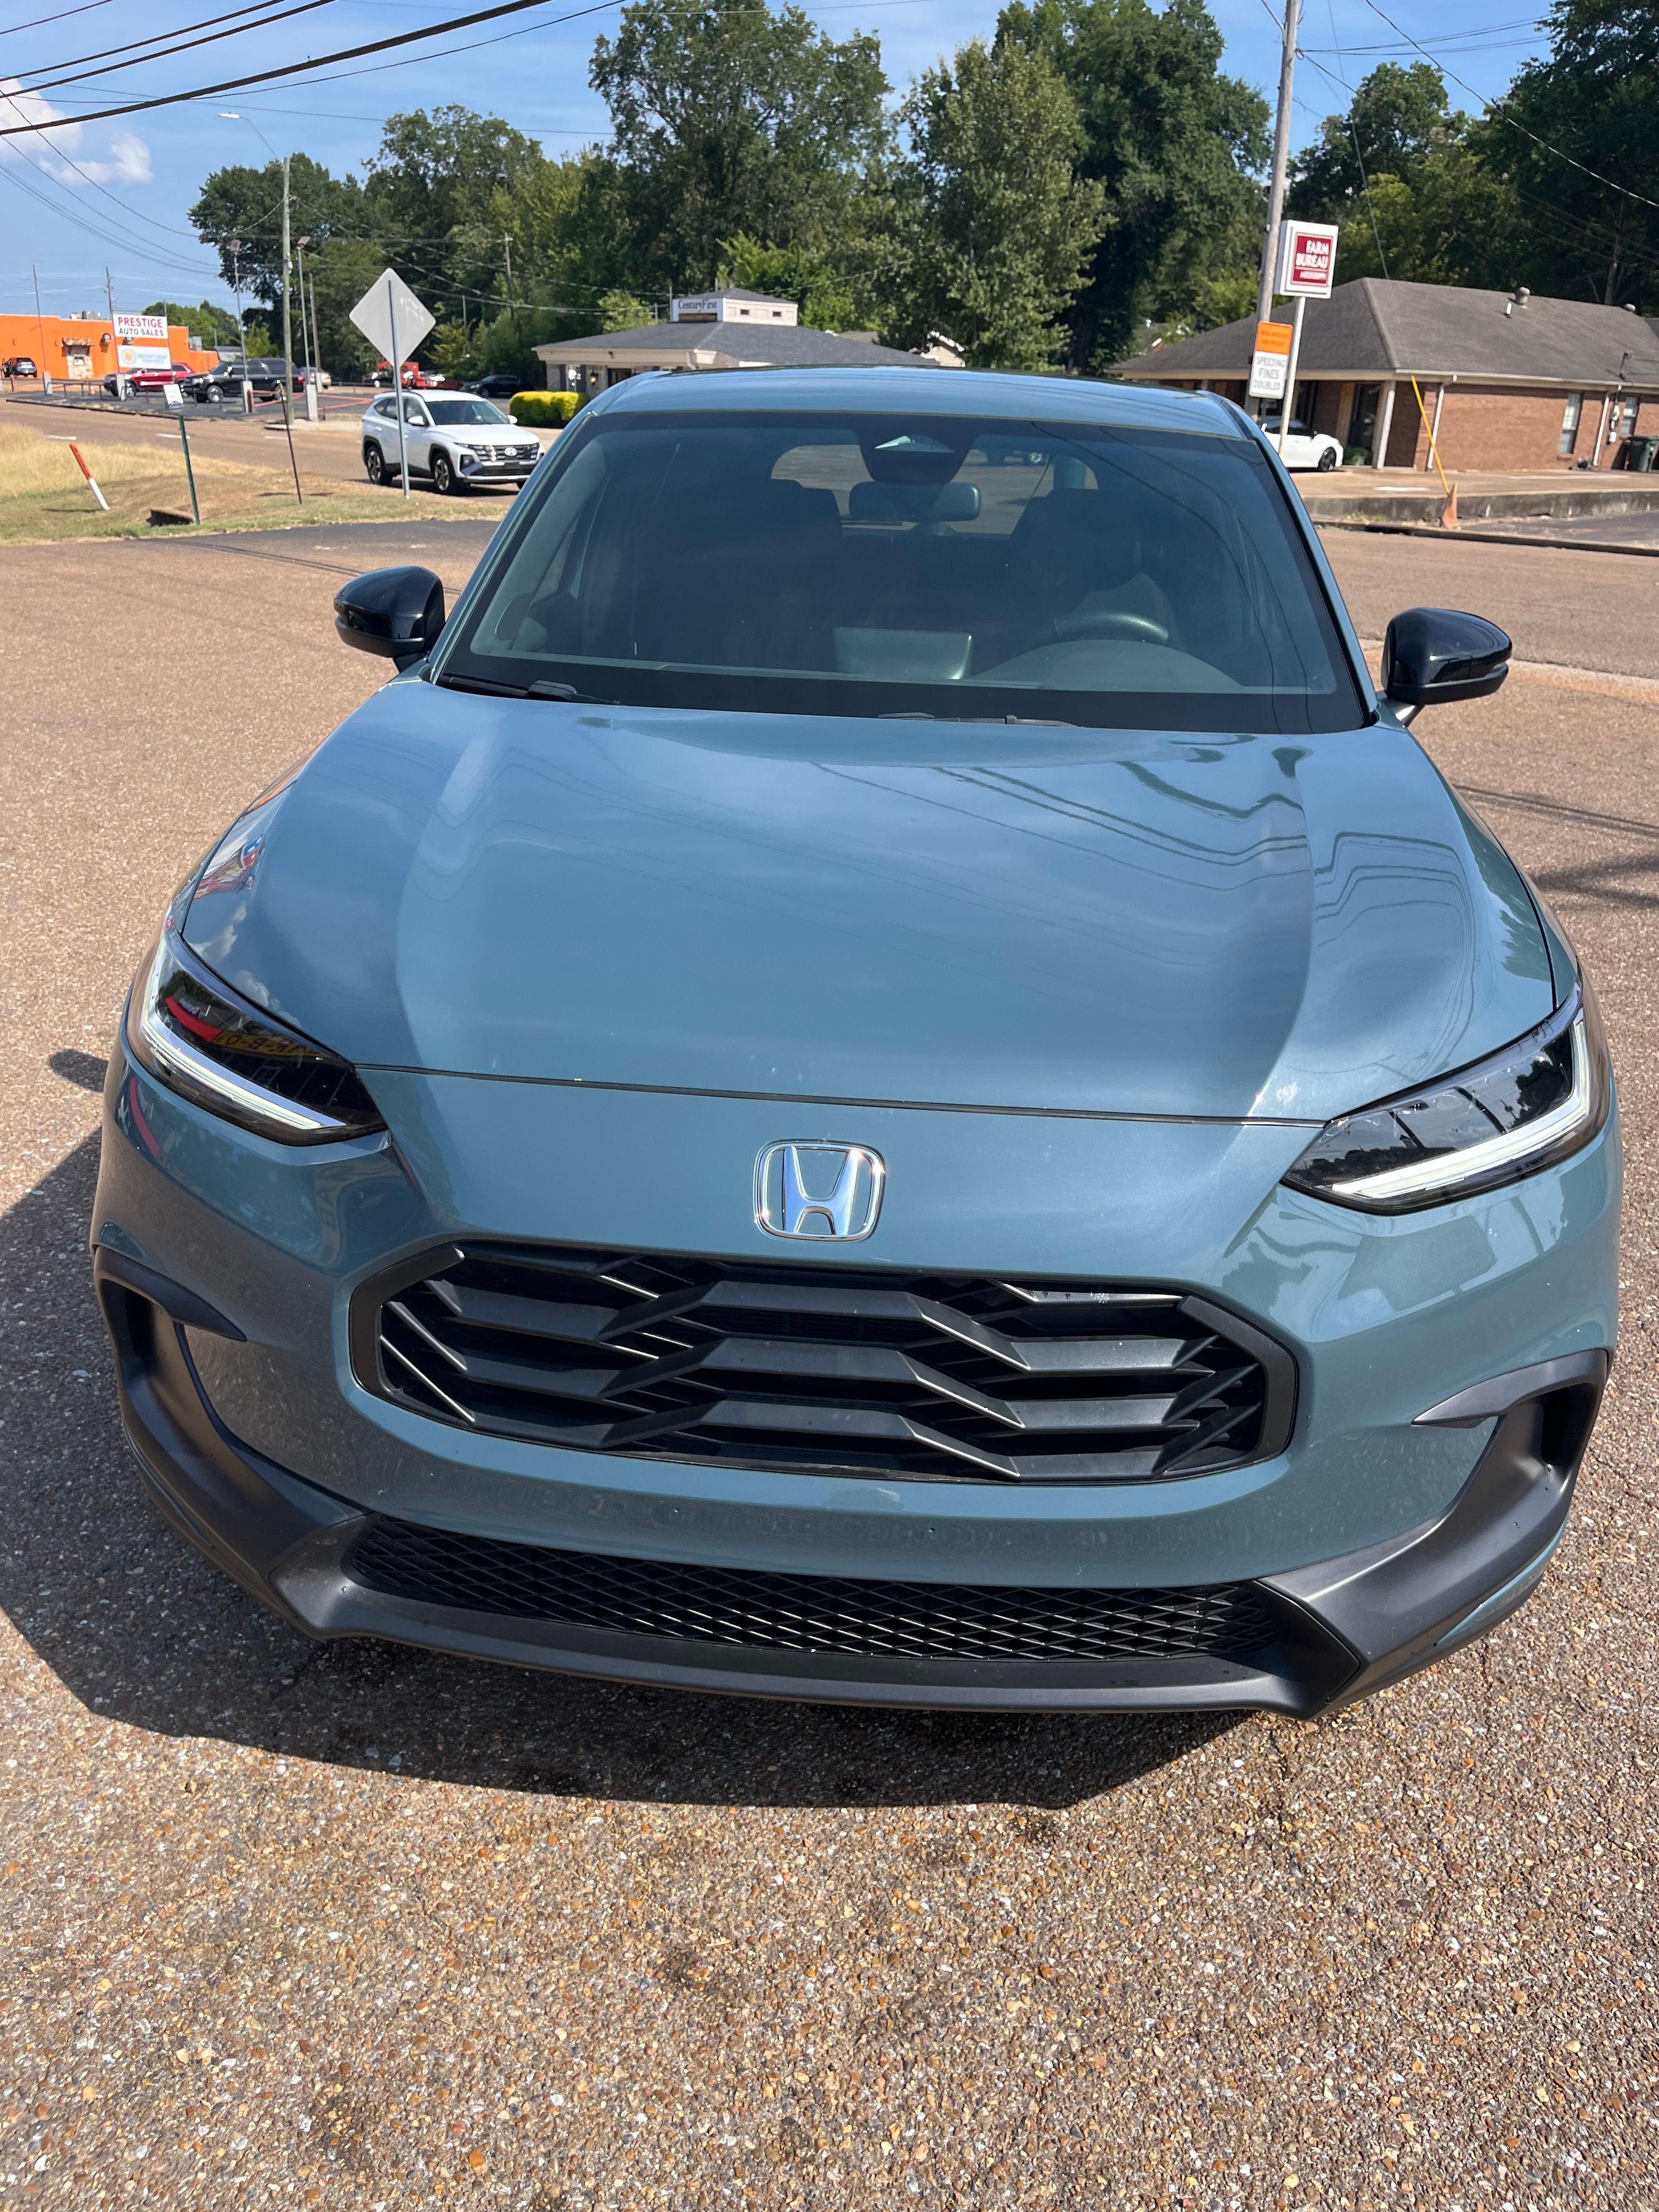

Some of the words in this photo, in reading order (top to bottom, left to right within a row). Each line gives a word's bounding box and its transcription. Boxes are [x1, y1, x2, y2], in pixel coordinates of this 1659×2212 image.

[1306, 240, 1329, 255] FARM
[1295, 252, 1329, 269] BUREAU
[118, 317, 163, 328] PRESTIGE
[1256, 357, 1286, 368] SPEEDING
[1258, 367, 1280, 380] FINES
[1253, 380, 1280, 391] DOUBLED
